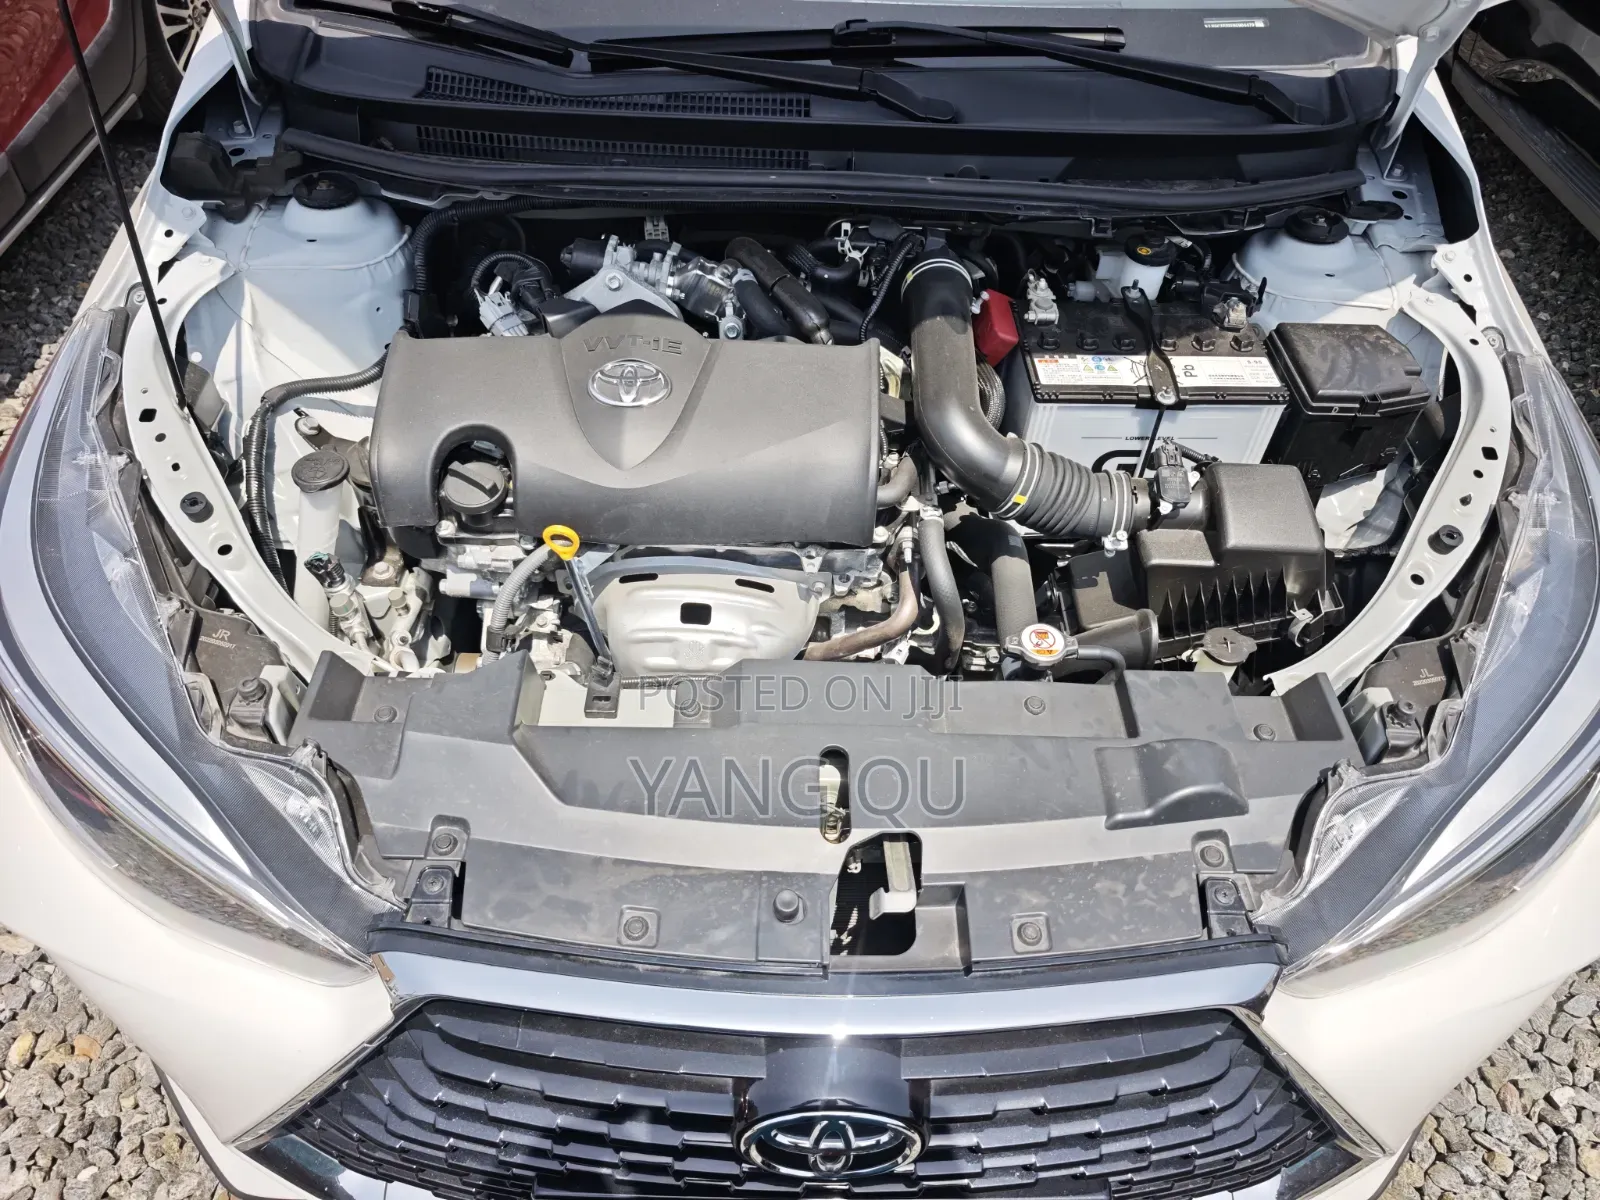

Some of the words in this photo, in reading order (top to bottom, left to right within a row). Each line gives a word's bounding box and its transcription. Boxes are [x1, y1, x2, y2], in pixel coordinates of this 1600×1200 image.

[1182, 364, 1198, 377] Pb
[212, 629, 231, 640] JR
[1420, 668, 1434, 678] JL
